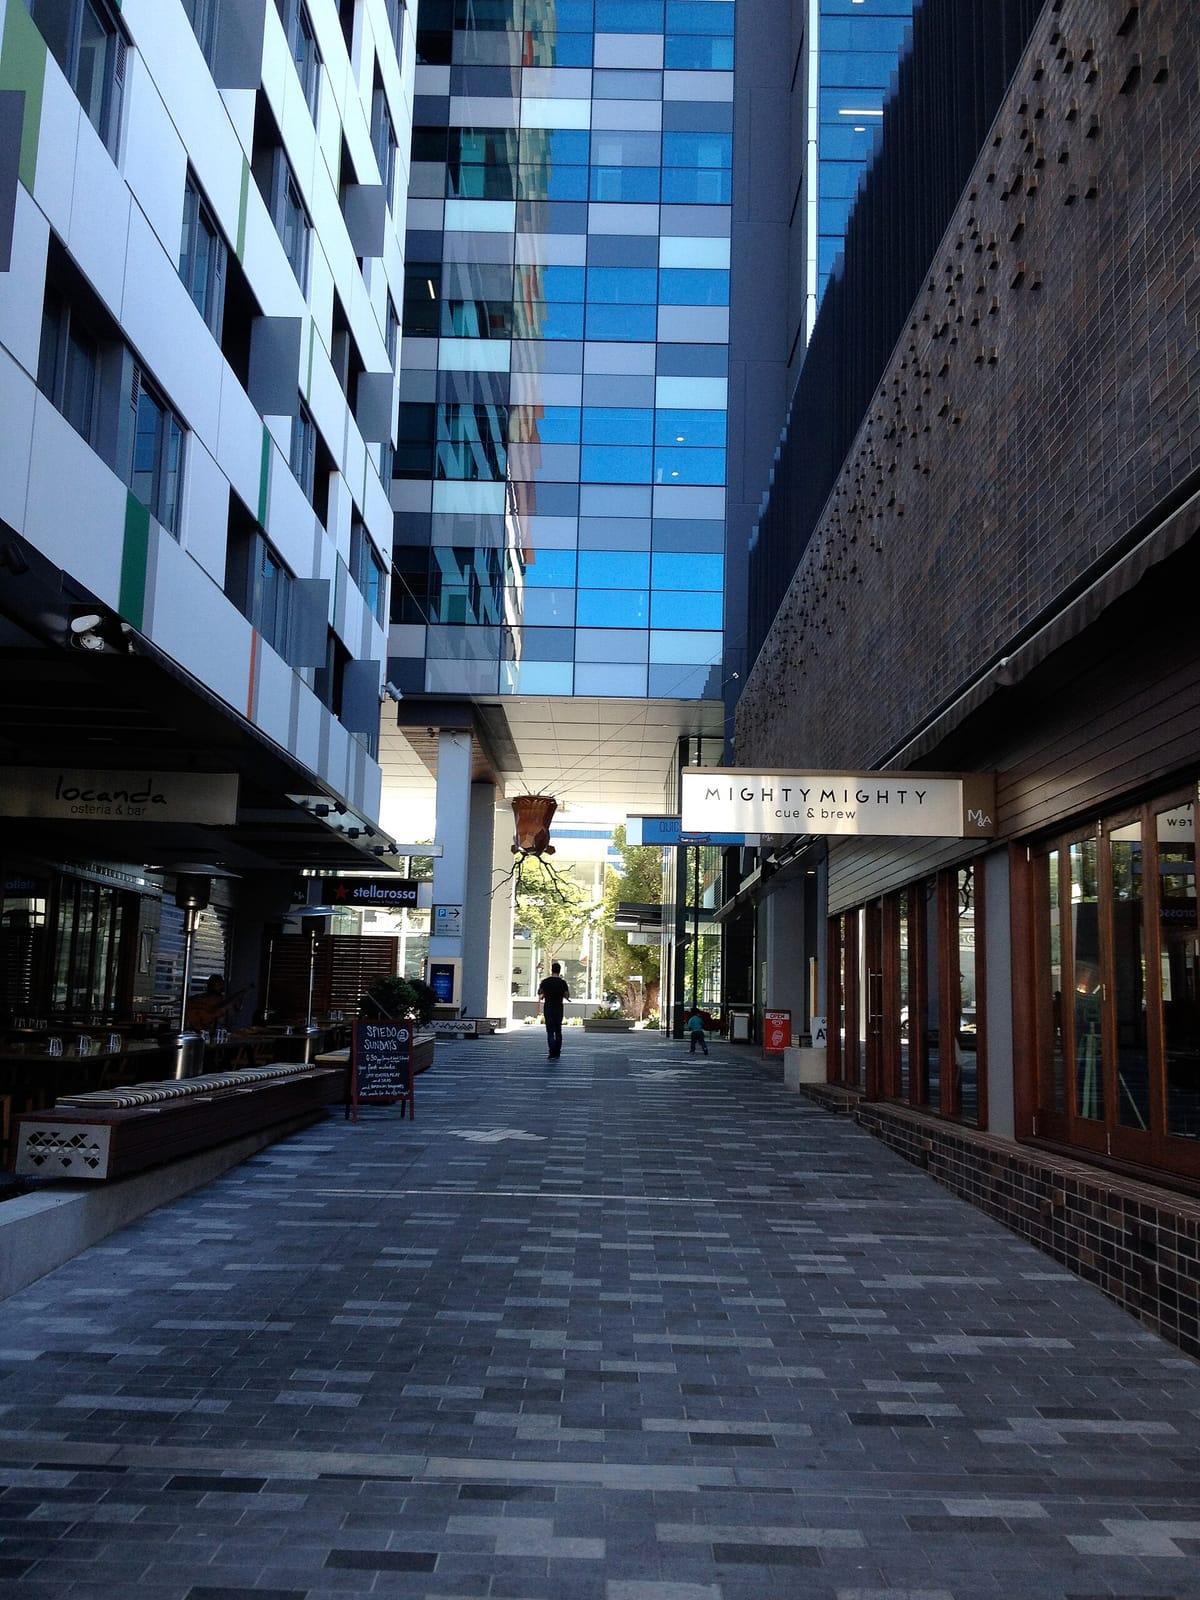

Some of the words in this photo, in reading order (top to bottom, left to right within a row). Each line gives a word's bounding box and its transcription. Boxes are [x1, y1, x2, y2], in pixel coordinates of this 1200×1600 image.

[55, 776, 167, 804] locanda
[71, 803, 112, 815] osteria
[115, 805, 123, 815] &
[127, 806, 147, 816] bar
[775, 809, 800, 818] cue
[807, 808, 815, 818] &
[821, 808, 856, 819] brew
[353, 885, 416, 899] stellarossa
[366, 1025, 397, 1038] SPIEDO
[363, 1039, 397, 1051] SUNDAYS
